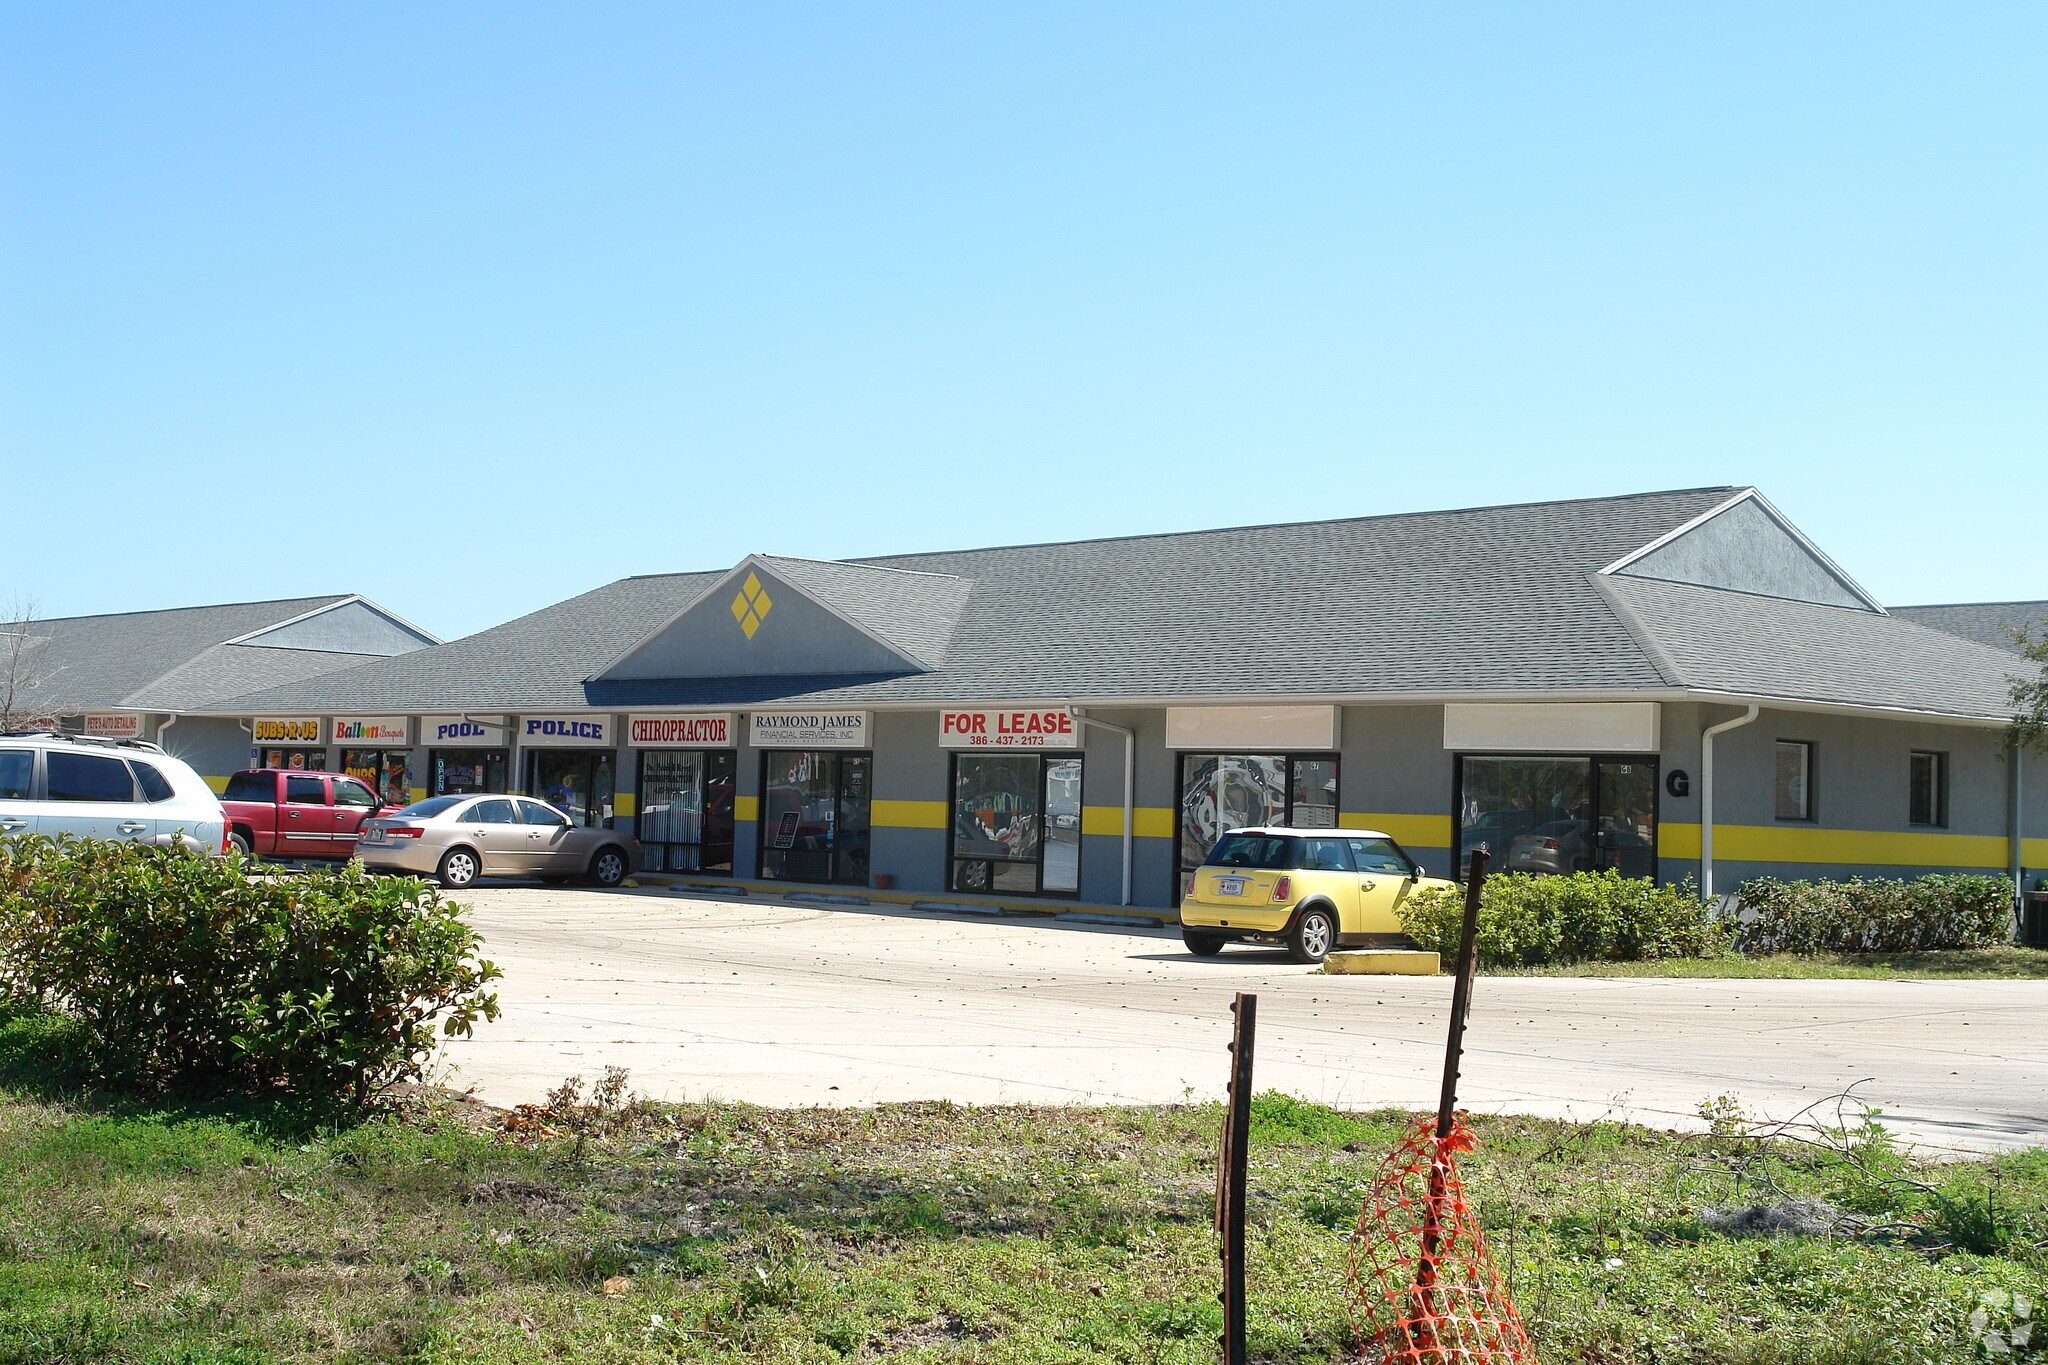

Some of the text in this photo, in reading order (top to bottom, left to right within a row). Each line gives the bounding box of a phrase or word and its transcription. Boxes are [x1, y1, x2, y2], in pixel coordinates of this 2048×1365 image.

[114, 716, 137, 730] DETAILING
[336, 721, 404, 742] Balloon Bouquets
[437, 722, 485, 740] POOL
[526, 720, 603, 740] POLICE
[632, 719, 727, 742] CHIROPRACTOR
[755, 715, 862, 730] RAYMOND JAMES
[943, 712, 1072, 734] FOR LEASE
[760, 730, 798, 739] FINANCIAL
[1666, 769, 1689, 798] G
